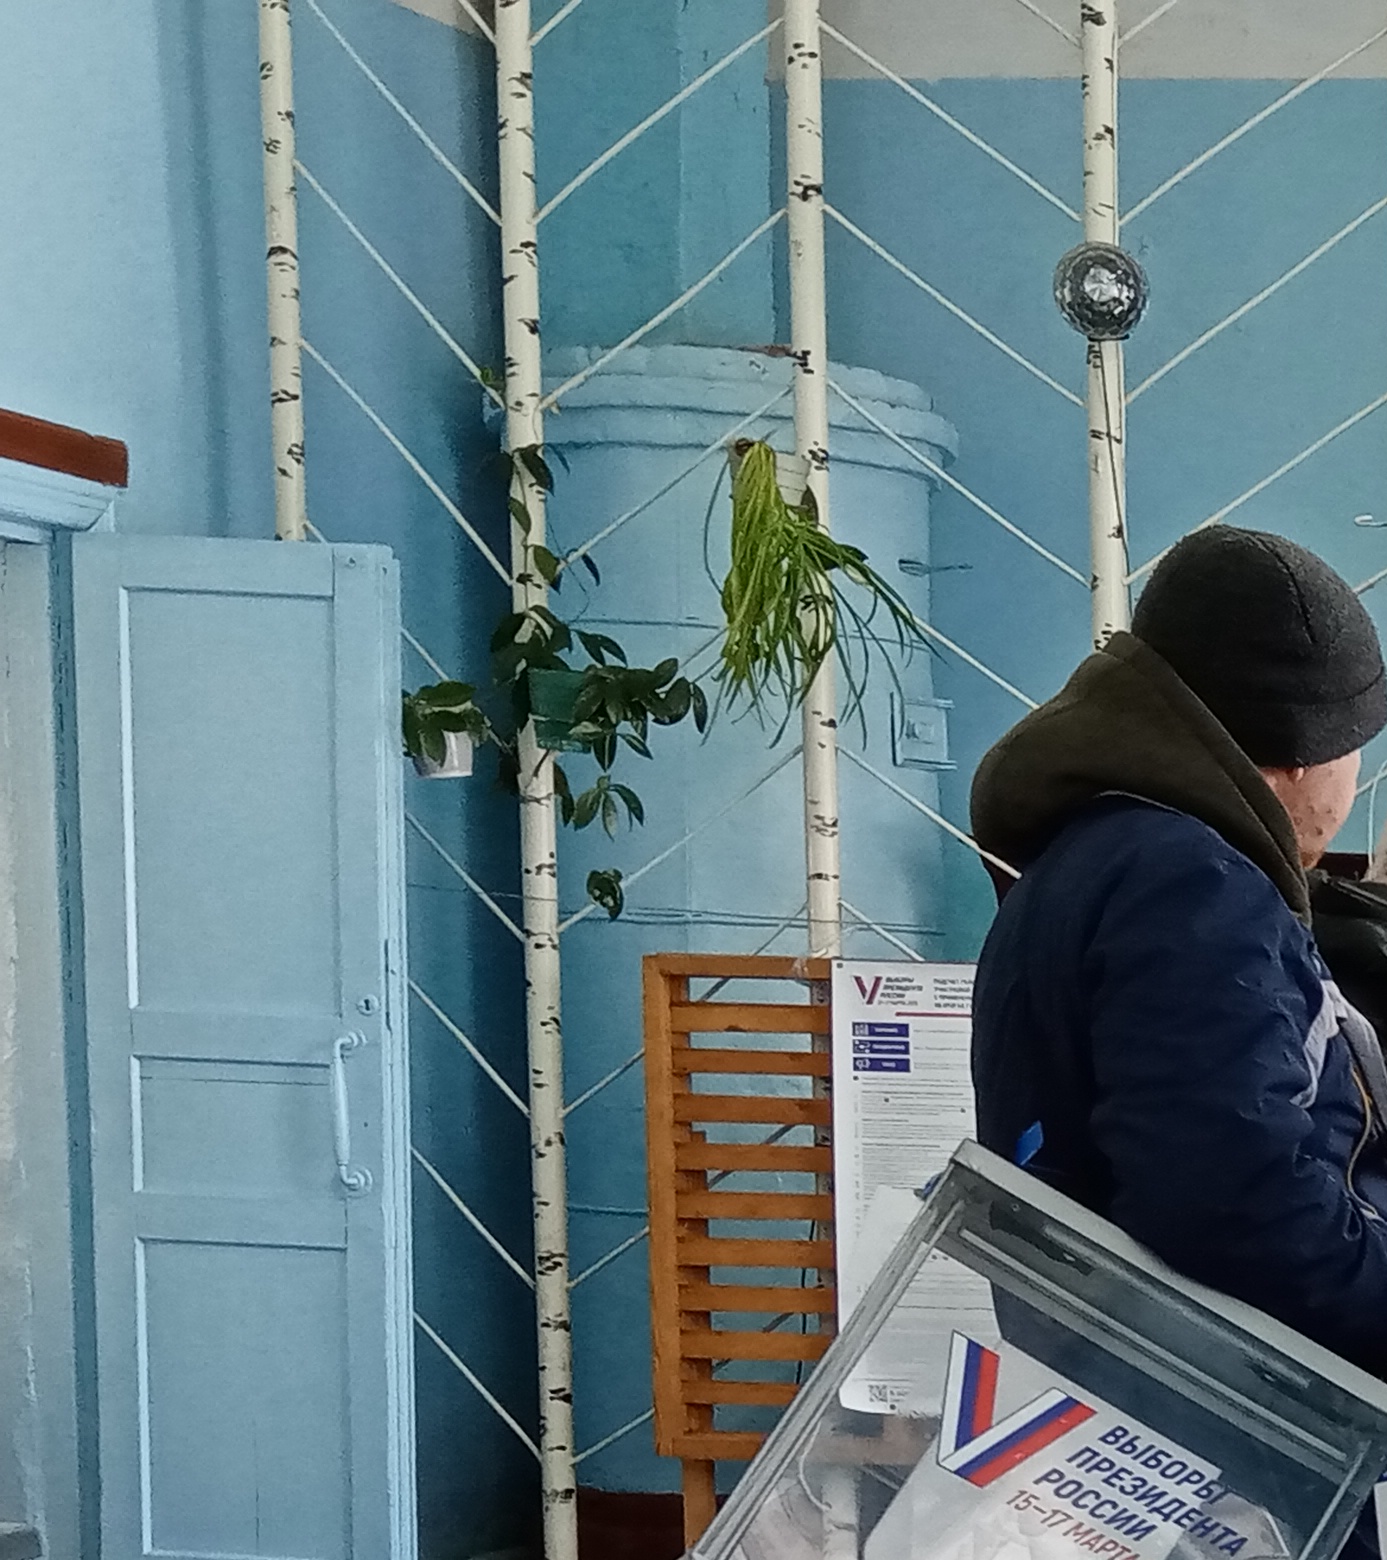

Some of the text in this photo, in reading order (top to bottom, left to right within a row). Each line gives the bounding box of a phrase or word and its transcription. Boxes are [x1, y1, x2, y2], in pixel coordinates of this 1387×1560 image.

[1065, 1446, 1249, 1557] ПРЕЗИДЕНТА
[1098, 1425, 1228, 1504] ВЫБОРЫ
[1033, 1468, 1158, 1541] РОССИИ
